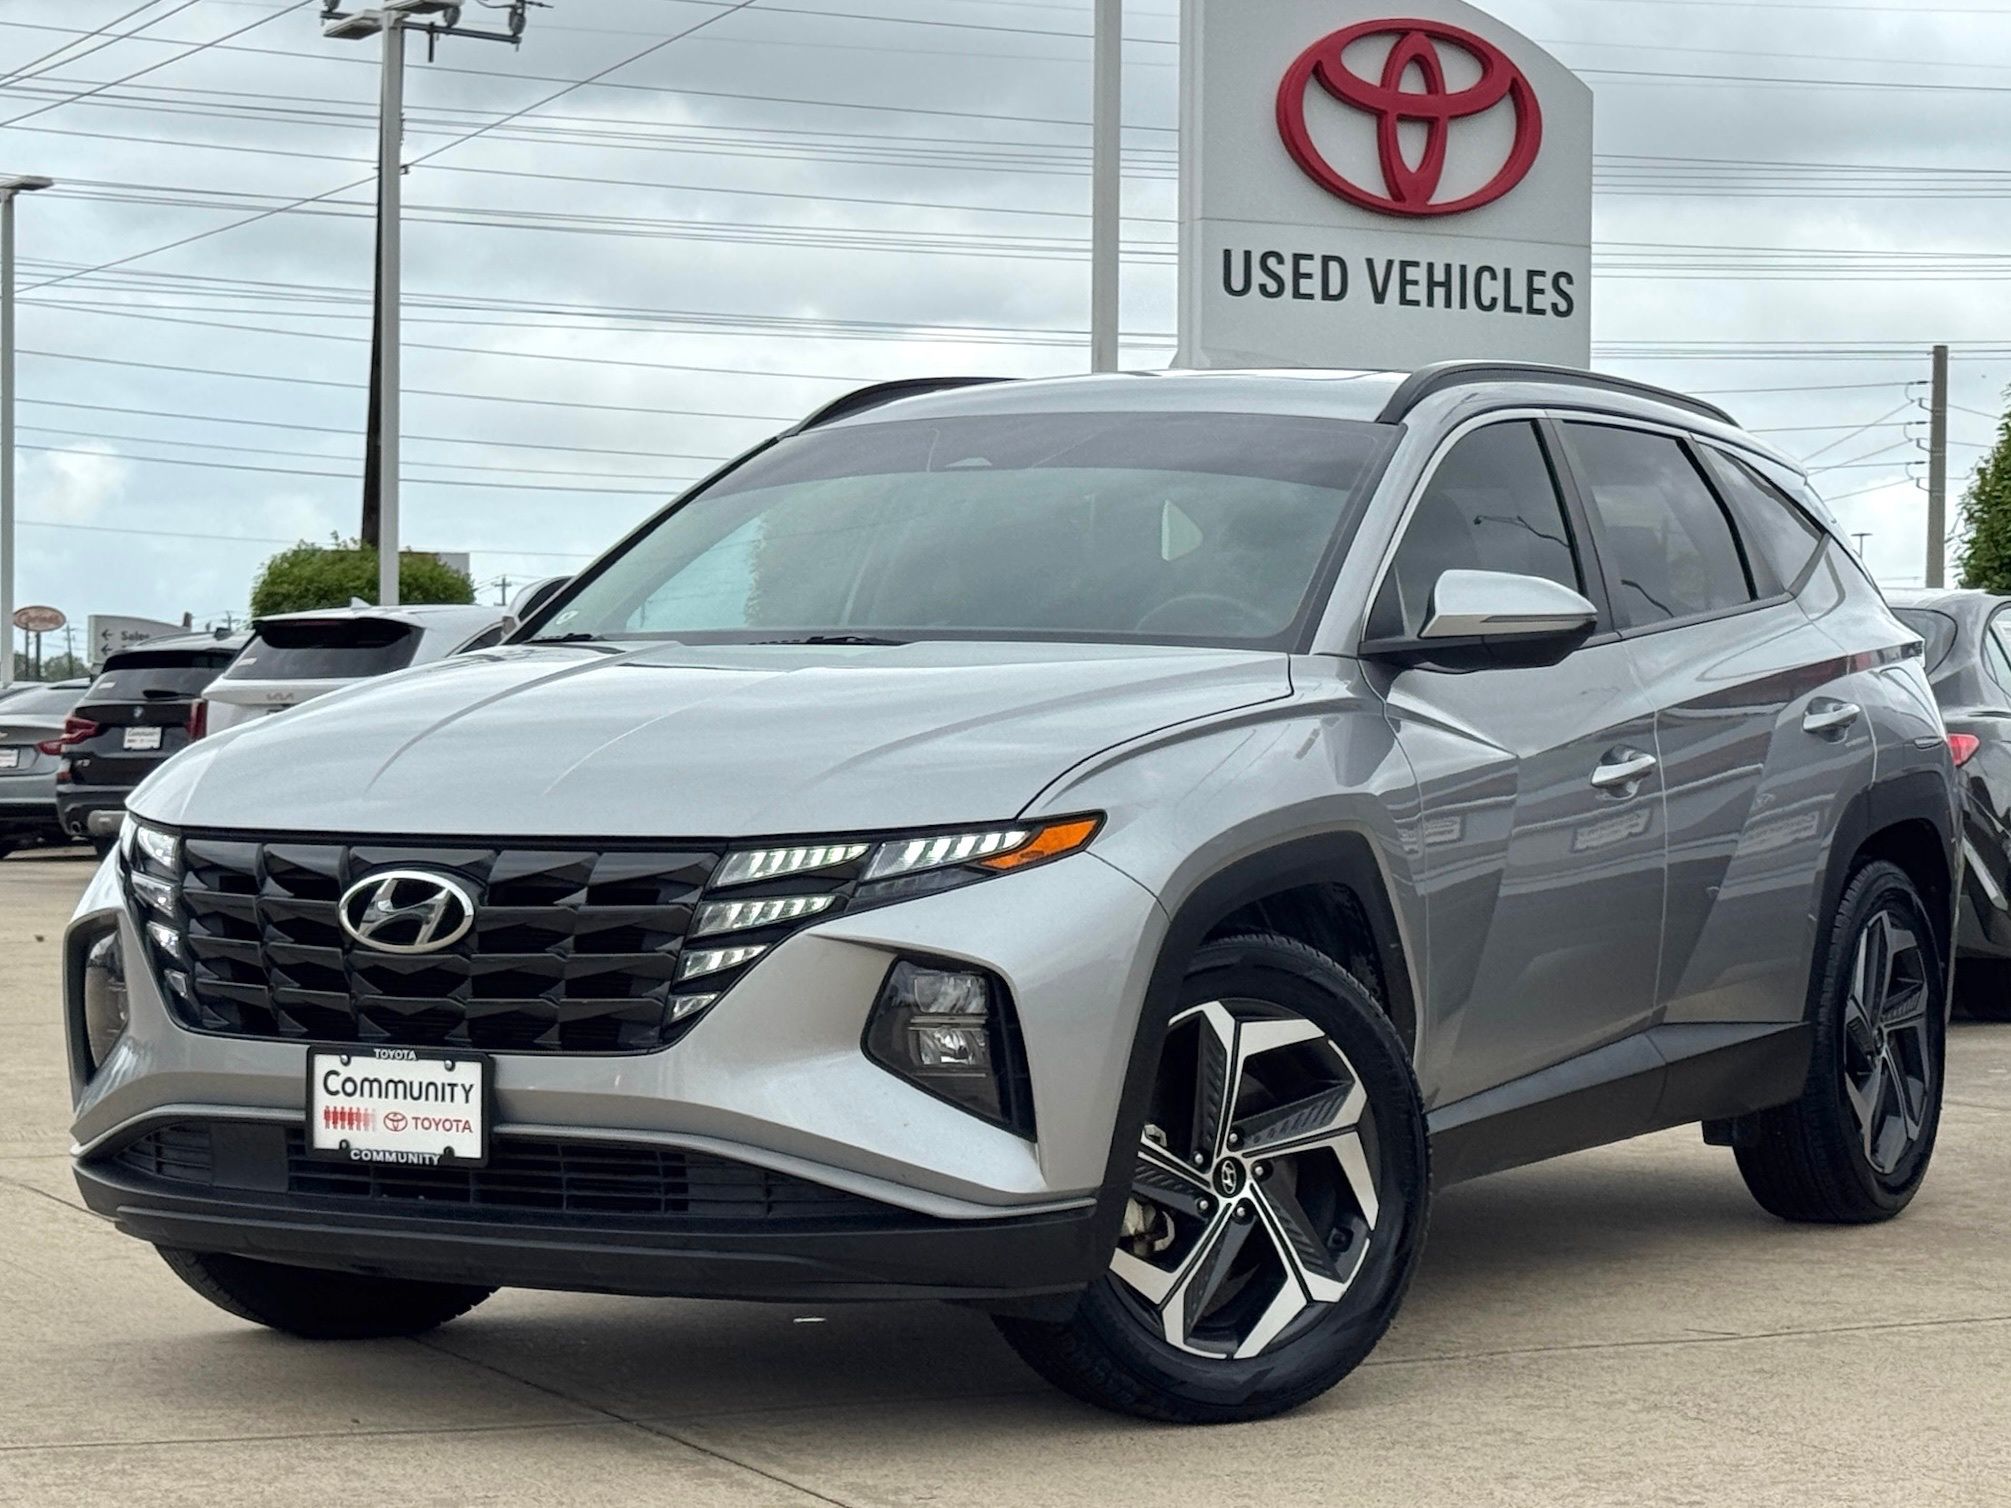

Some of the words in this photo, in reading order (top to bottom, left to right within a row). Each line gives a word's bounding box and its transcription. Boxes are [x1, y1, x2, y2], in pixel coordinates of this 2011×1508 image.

[1222, 248, 1349, 302] USED
[1366, 256, 1575, 319] VEHICLES
[121, 630, 150, 641] Sales
[373, 1048, 418, 1061] TOYOTA
[412, 1116, 473, 1134] TOYOTA
[350, 1148, 441, 1166] COMMUNITY
